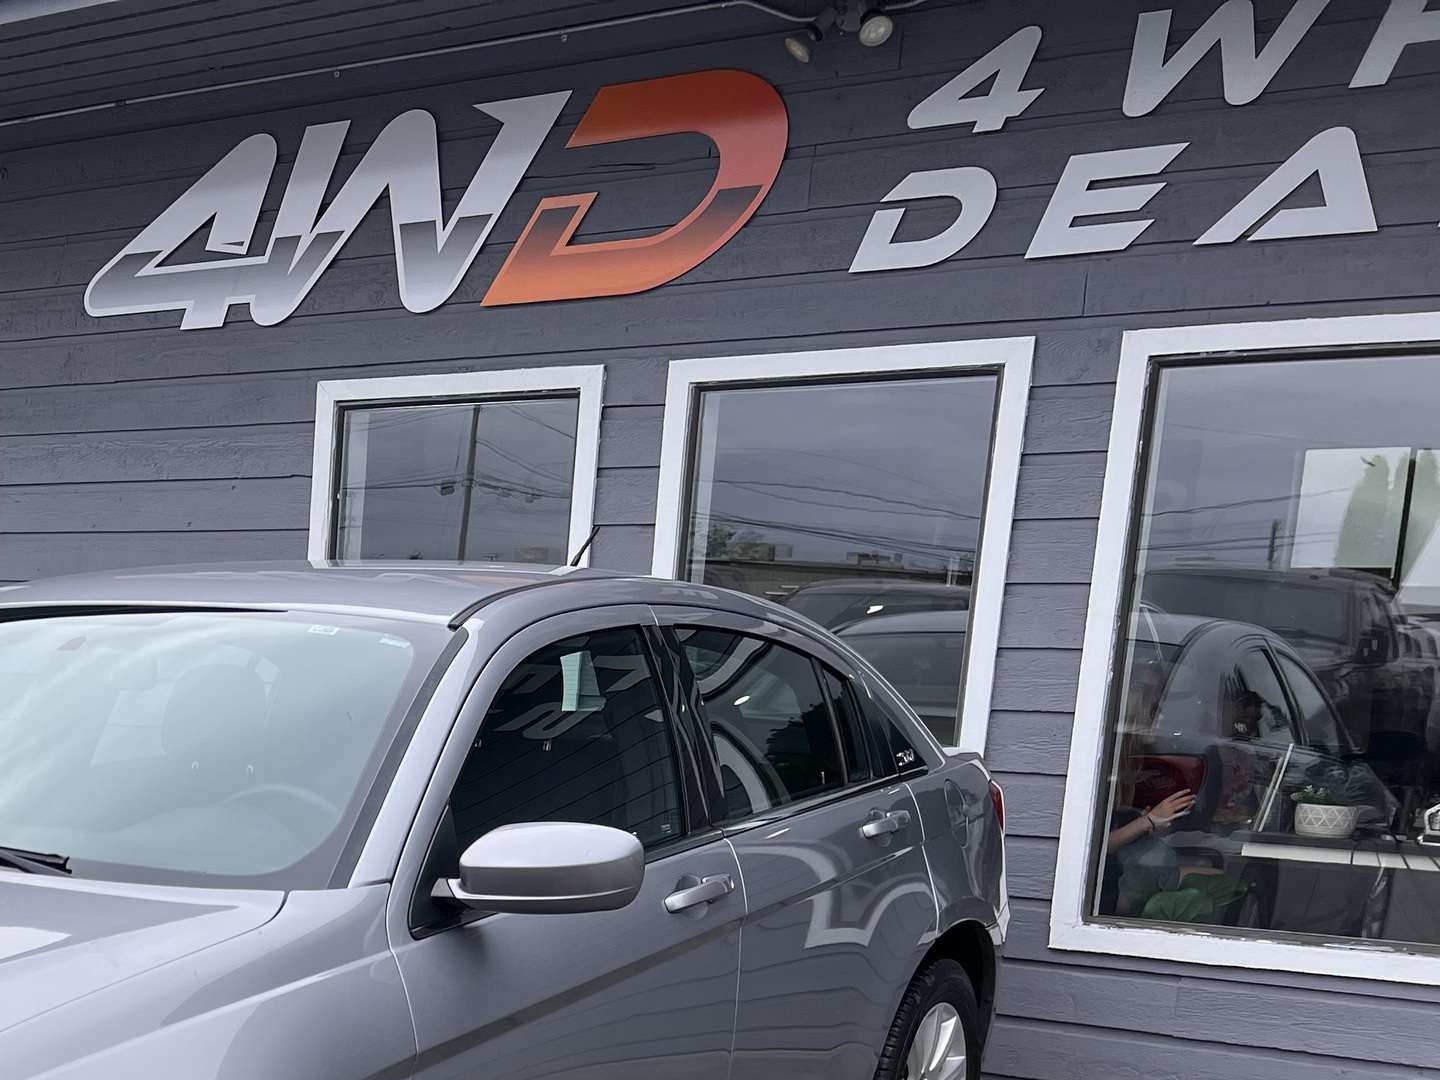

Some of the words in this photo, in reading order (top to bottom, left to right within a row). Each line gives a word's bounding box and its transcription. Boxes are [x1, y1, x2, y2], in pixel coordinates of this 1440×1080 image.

[907, 25, 1046, 133] 4
[84, 69, 789, 330] 4WD
[848, 126, 1440, 274] DEA
